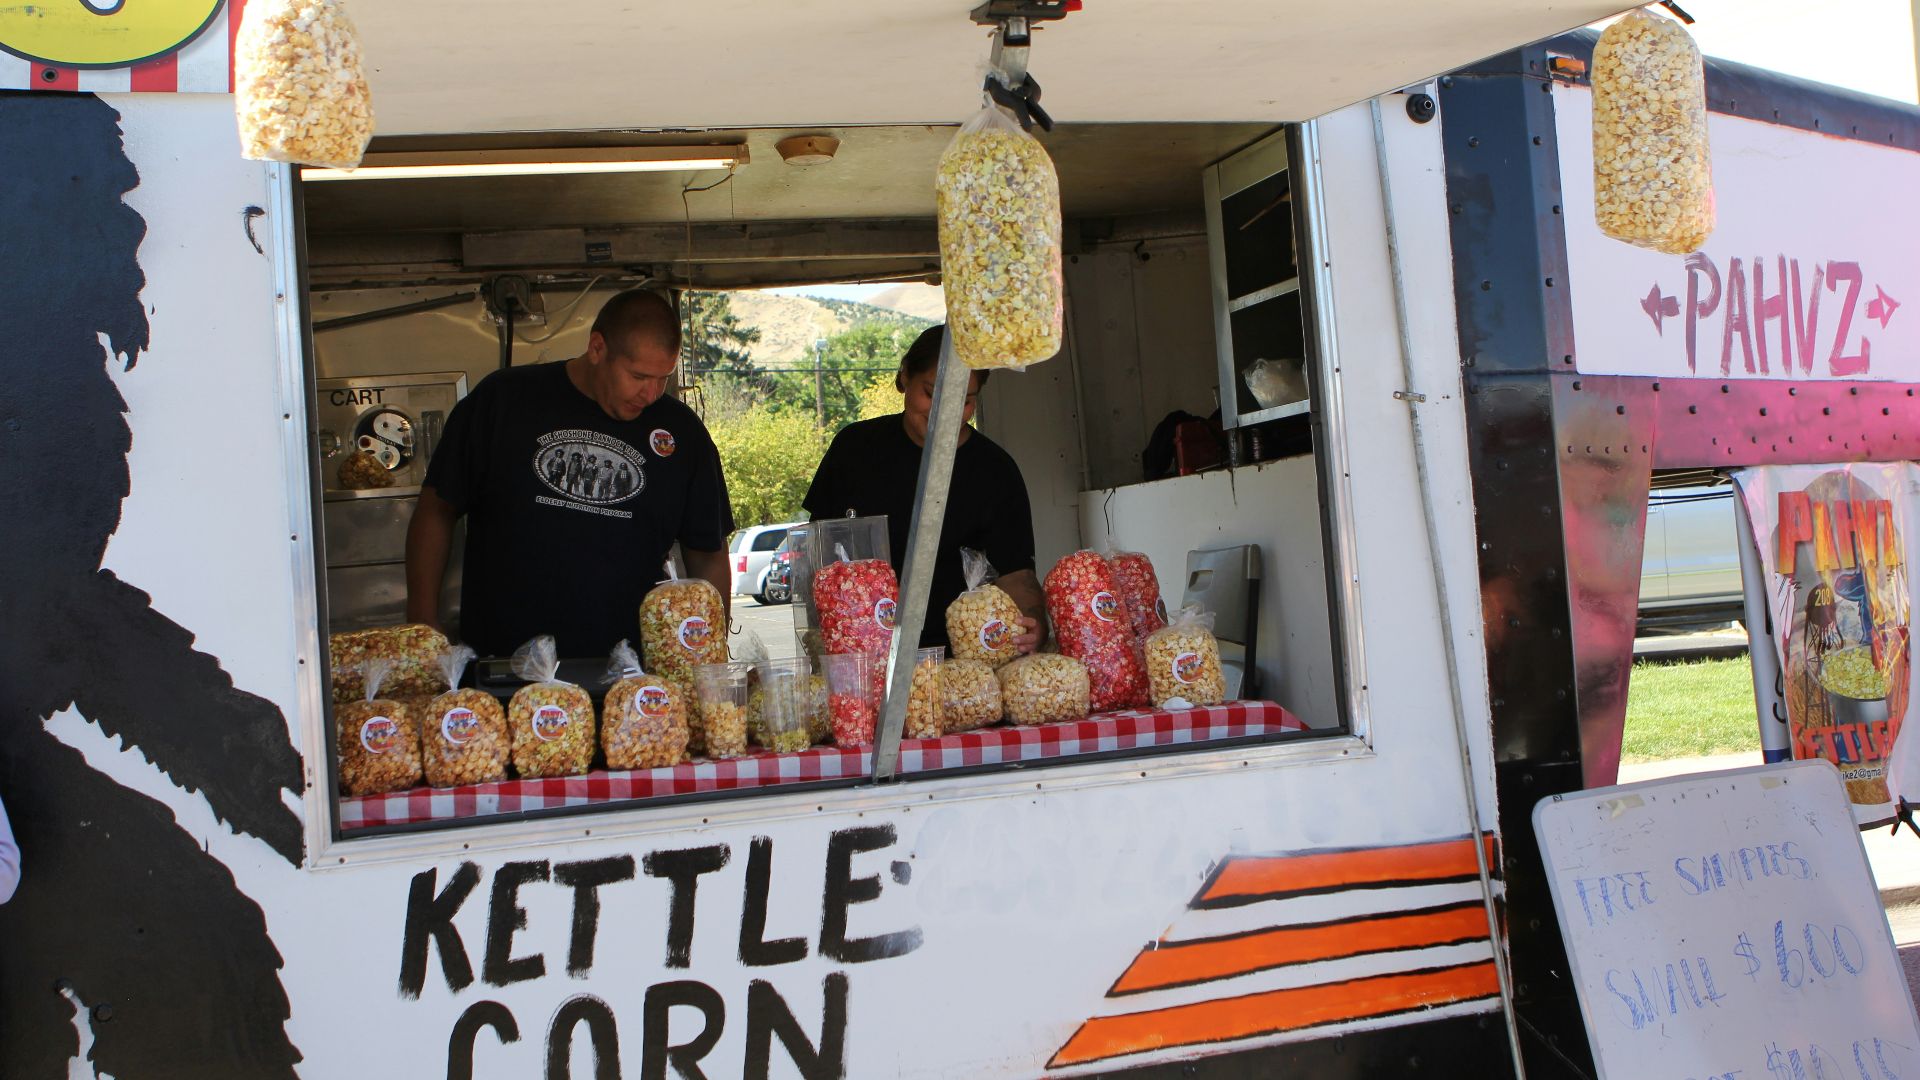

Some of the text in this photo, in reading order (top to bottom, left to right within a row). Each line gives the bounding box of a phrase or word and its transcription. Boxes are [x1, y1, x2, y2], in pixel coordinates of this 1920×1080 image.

[1684, 252, 1871, 377] PAHVZ
[330, 388, 386, 407] CART
[536, 432, 554, 446] THE
[553, 429, 593, 441] SHOSHONE
[566, 501, 600, 514] NUTRITION
[600, 507, 633, 519] PROGRAM
[398, 822, 923, 1000] KETTLE
[1573, 841, 1811, 928] FREE SAMPLES
[447, 971, 850, 1080] CORN
[1604, 956, 1728, 1031] SMALL
